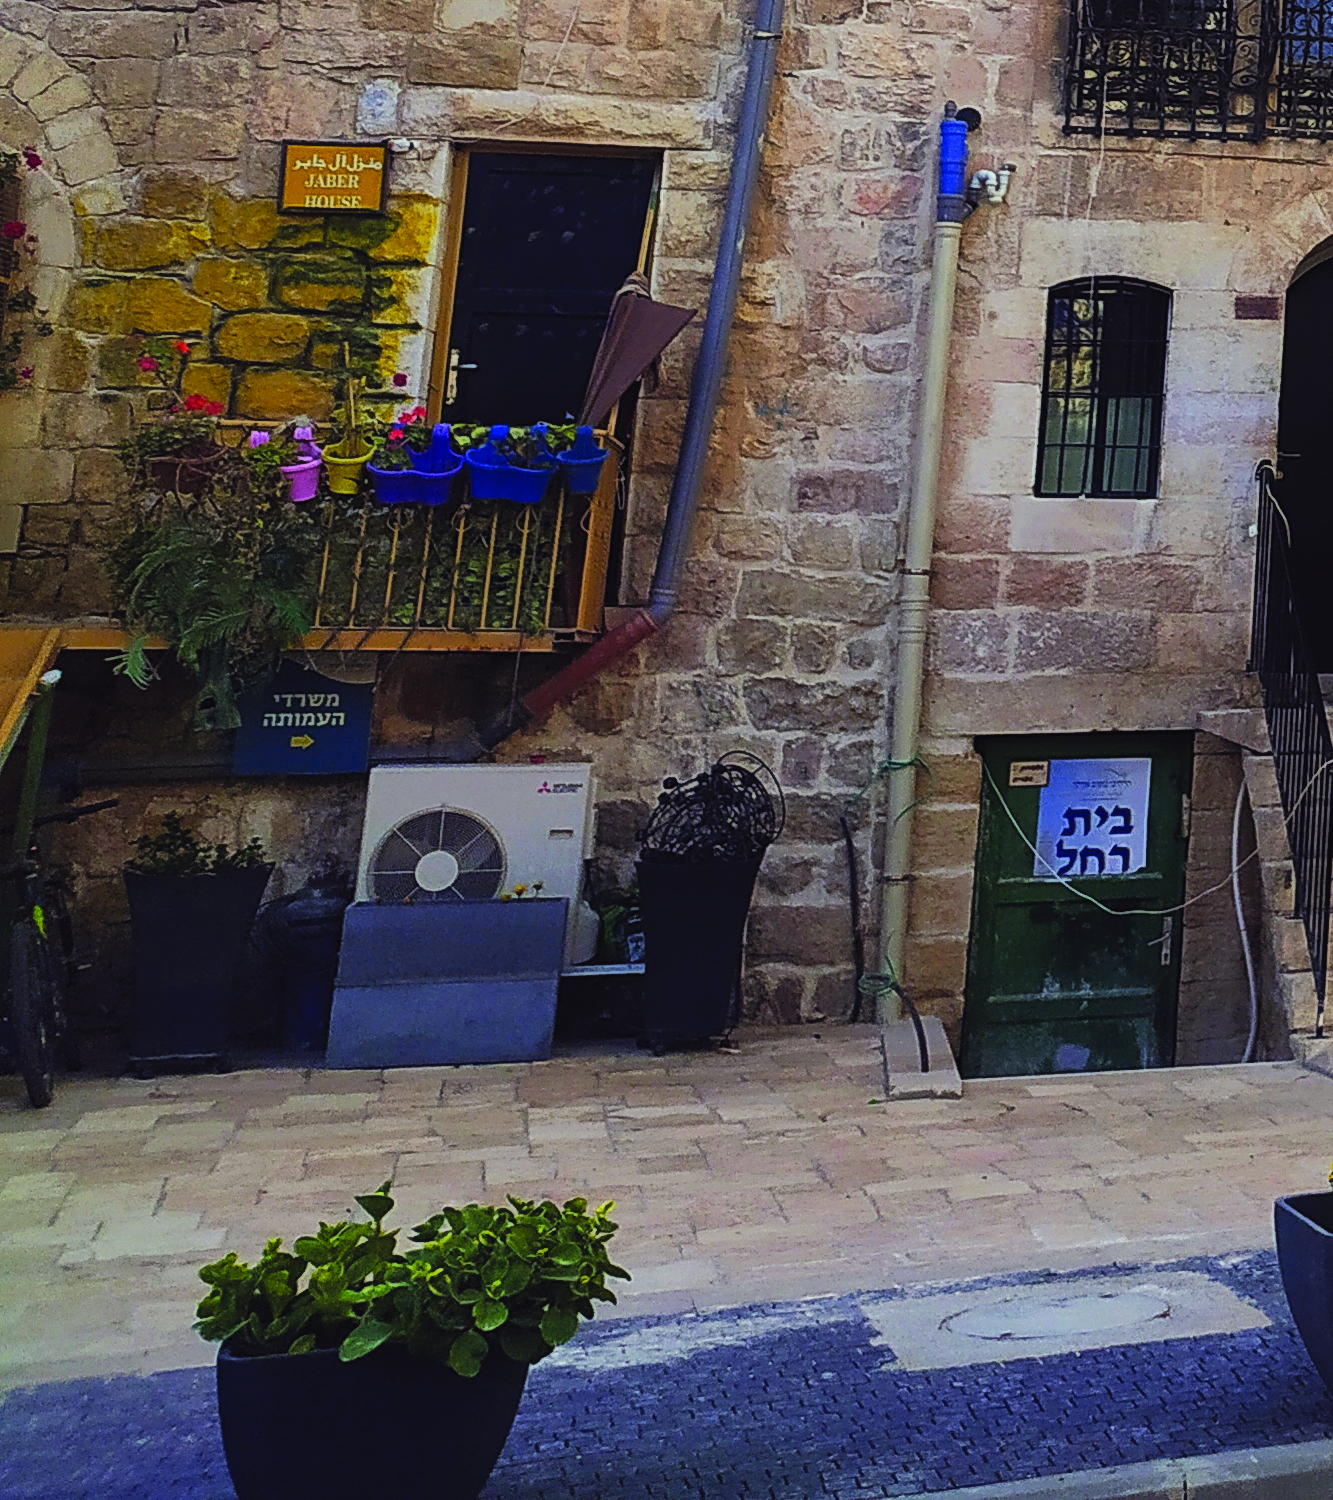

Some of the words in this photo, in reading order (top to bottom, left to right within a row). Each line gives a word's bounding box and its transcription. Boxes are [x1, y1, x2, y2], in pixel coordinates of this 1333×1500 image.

[304, 173, 359, 189] JABER
[304, 195, 362, 208] HOUSE
[273, 692, 340, 708] משרדי
[262, 711, 346, 727] העמותה
[1060, 805, 1134, 837] בית
[1055, 839, 1131, 876] רחל
